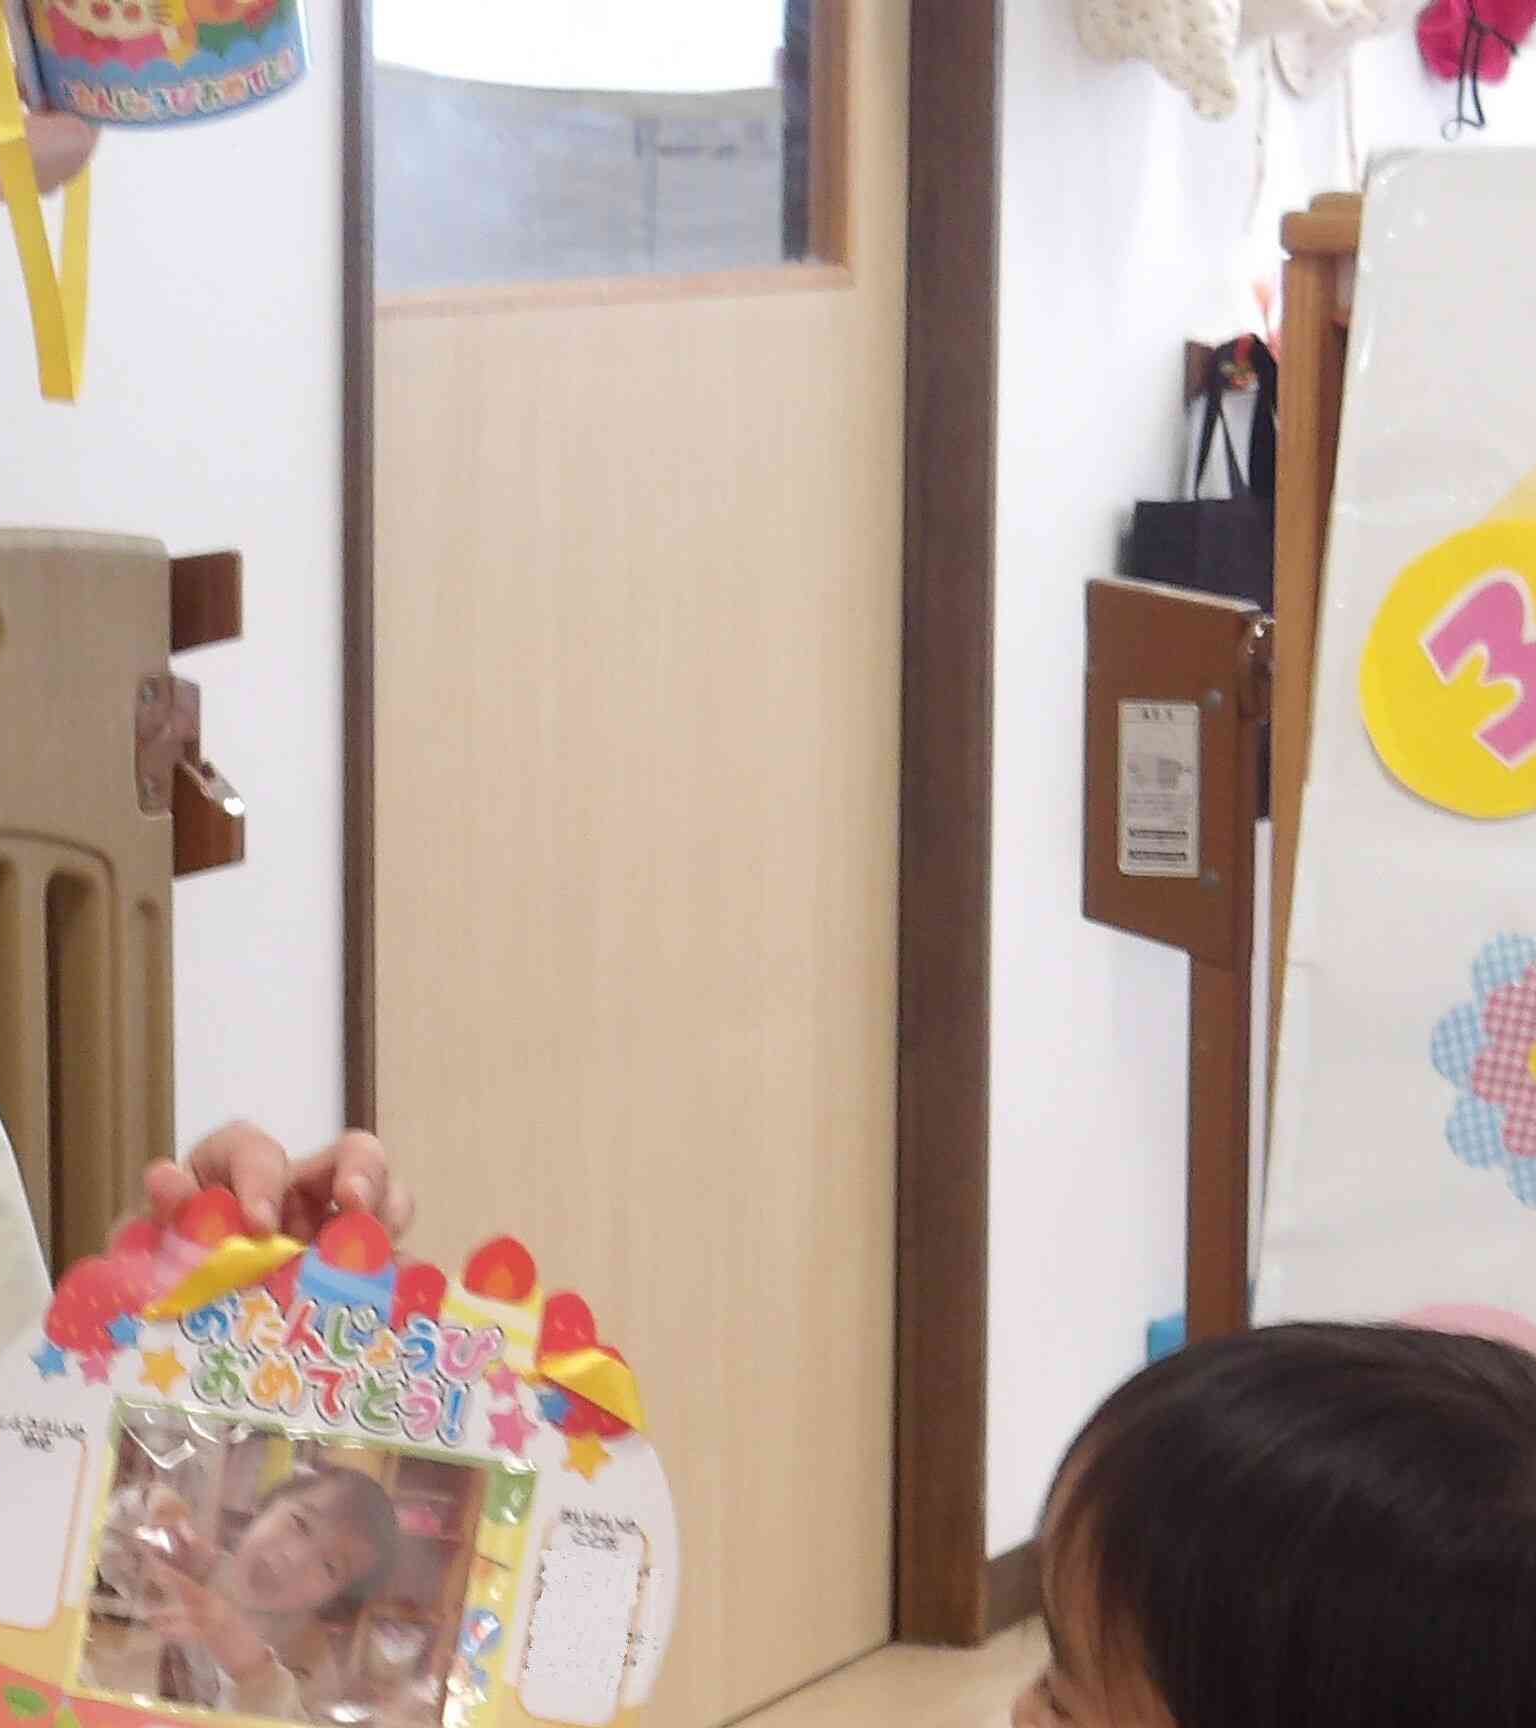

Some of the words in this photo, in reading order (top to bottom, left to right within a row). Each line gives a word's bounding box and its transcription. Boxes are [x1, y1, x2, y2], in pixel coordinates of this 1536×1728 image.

[182, 1289, 502, 1378] おたんじょうび
